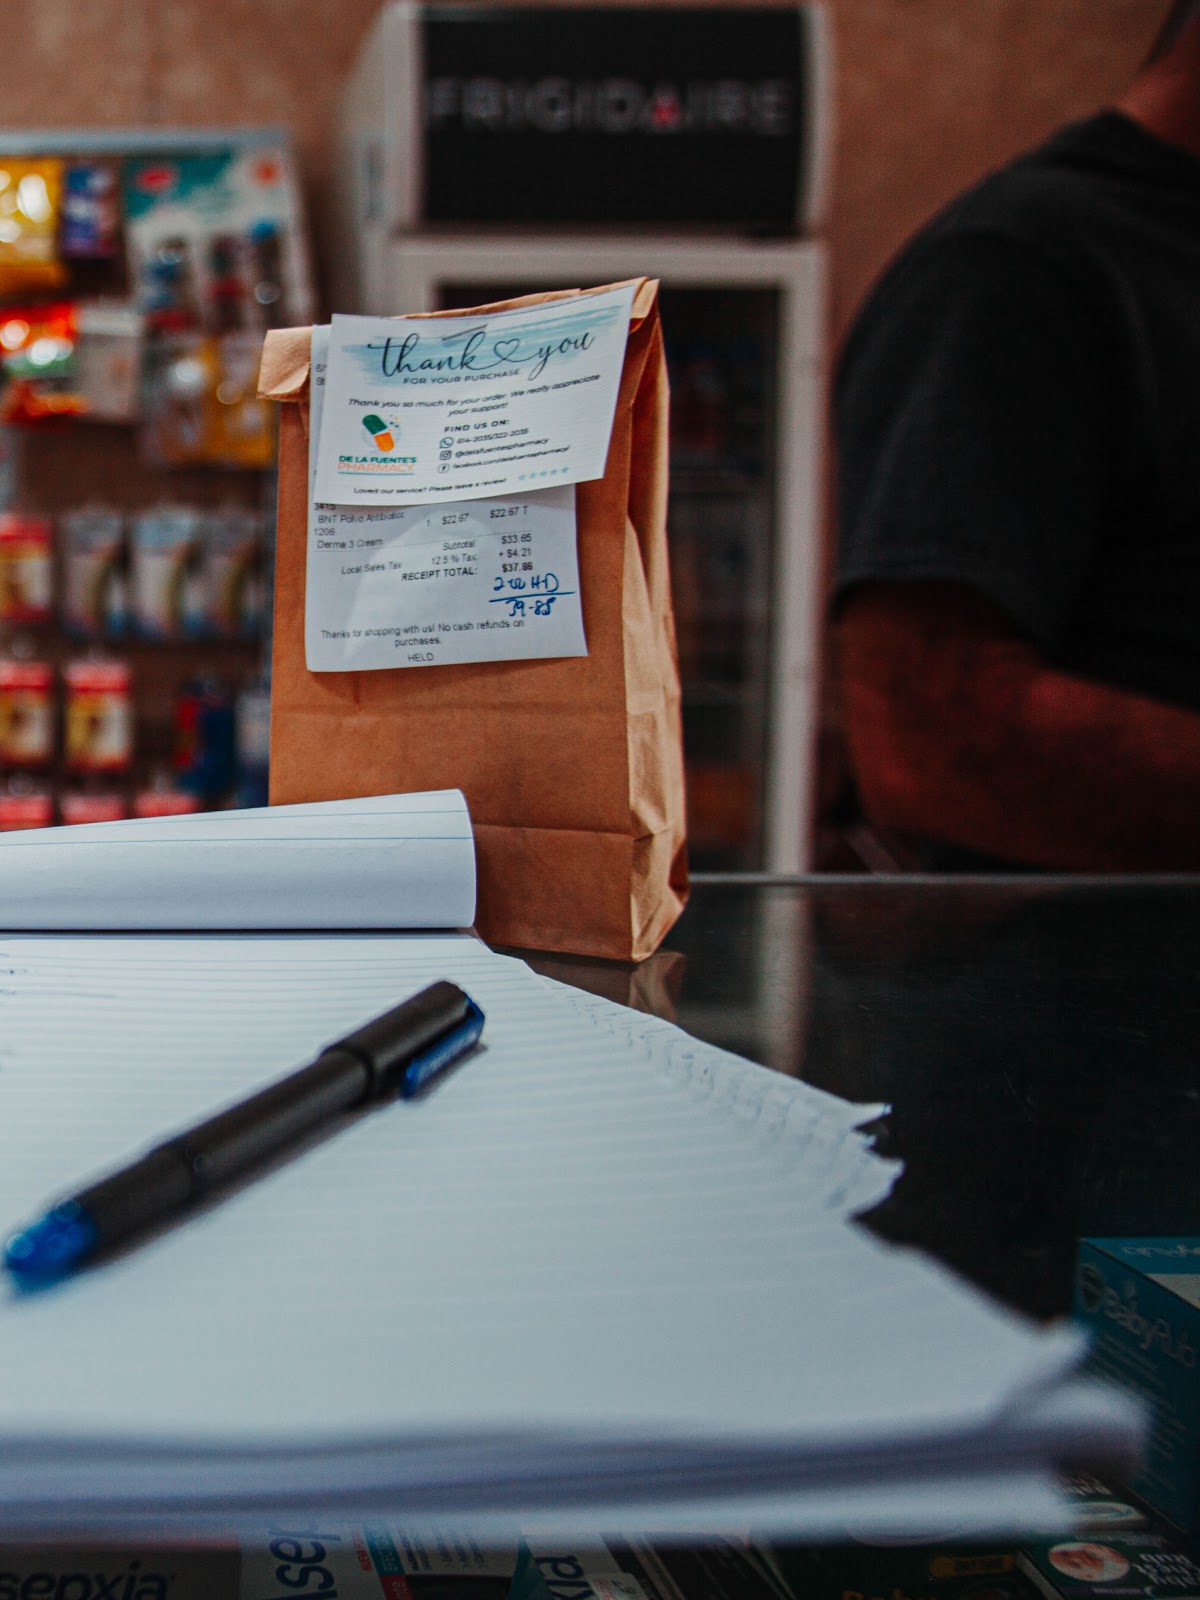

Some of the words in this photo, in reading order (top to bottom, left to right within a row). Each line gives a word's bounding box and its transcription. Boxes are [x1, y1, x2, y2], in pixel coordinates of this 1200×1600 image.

[428, 73, 793, 136] FRIGIDAIRE
[367, 331, 488, 377] thank
[528, 332, 595, 381] you
[403, 376, 427, 385] FOR
[430, 375, 461, 385] YOUR
[464, 368, 521, 382] PURCHASE
[348, 398, 380, 407] Thank
[381, 400, 400, 409] you
[460, 396, 482, 406] your
[510, 389, 525, 398] We
[526, 384, 551, 395] really
[552, 374, 601, 390] appreciate
[448, 407, 469, 417] your
[443, 424, 470, 432] FIND
[473, 422, 487, 430] US
[490, 419, 510, 427] ON:
[338, 455, 353, 463] DE
[370, 456, 417, 464] FUENTE'S
[337, 462, 415, 473] PHARMACY
[354, 487, 379, 495] Loved
[380, 487, 395, 495] our
[396, 486, 427, 494] service?
[428, 484, 453, 493] Please
[454, 482, 474, 490] leave
[318, 514, 338, 524] BNT
[313, 527, 336, 537] 1206
[317, 540, 346, 549] Derma
[348, 539, 355, 549] 3
[356, 538, 385, 548] Cream
[341, 566, 363, 576] Local
[364, 562, 386, 573] Sales
[401, 569, 441, 582] RECEIPT
[443, 566, 479, 577] TOTAL:
[320, 628, 351, 640] Thanks
[351, 628, 363, 638] for
[364, 625, 400, 639] shopping
[402, 624, 420, 635] with
[421, 623, 435, 634] us!
[437, 623, 451, 633] No
[452, 621, 474, 632] cash
[476, 619, 510, 630] refunds
[512, 619, 525, 628] on
[407, 652, 435, 663] HELD
